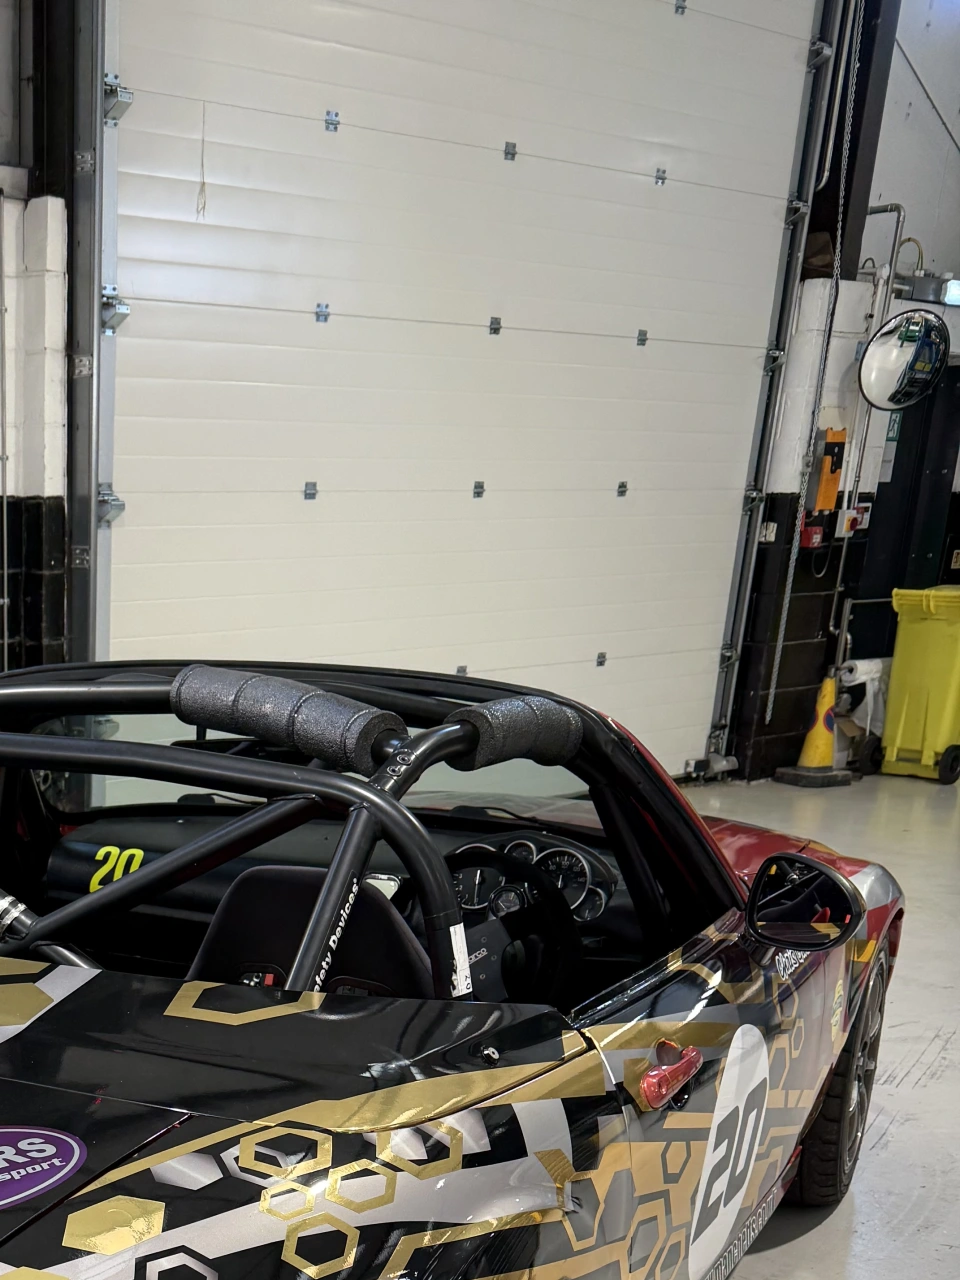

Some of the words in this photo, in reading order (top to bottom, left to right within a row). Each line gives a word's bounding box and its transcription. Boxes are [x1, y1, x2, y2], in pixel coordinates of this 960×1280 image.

[89, 845, 145, 893] 20
[313, 952, 332, 992] afety
[329, 883, 359, 951] Devices
[468, 948, 488, 965] arco
[691, 1076, 768, 1247] 20
